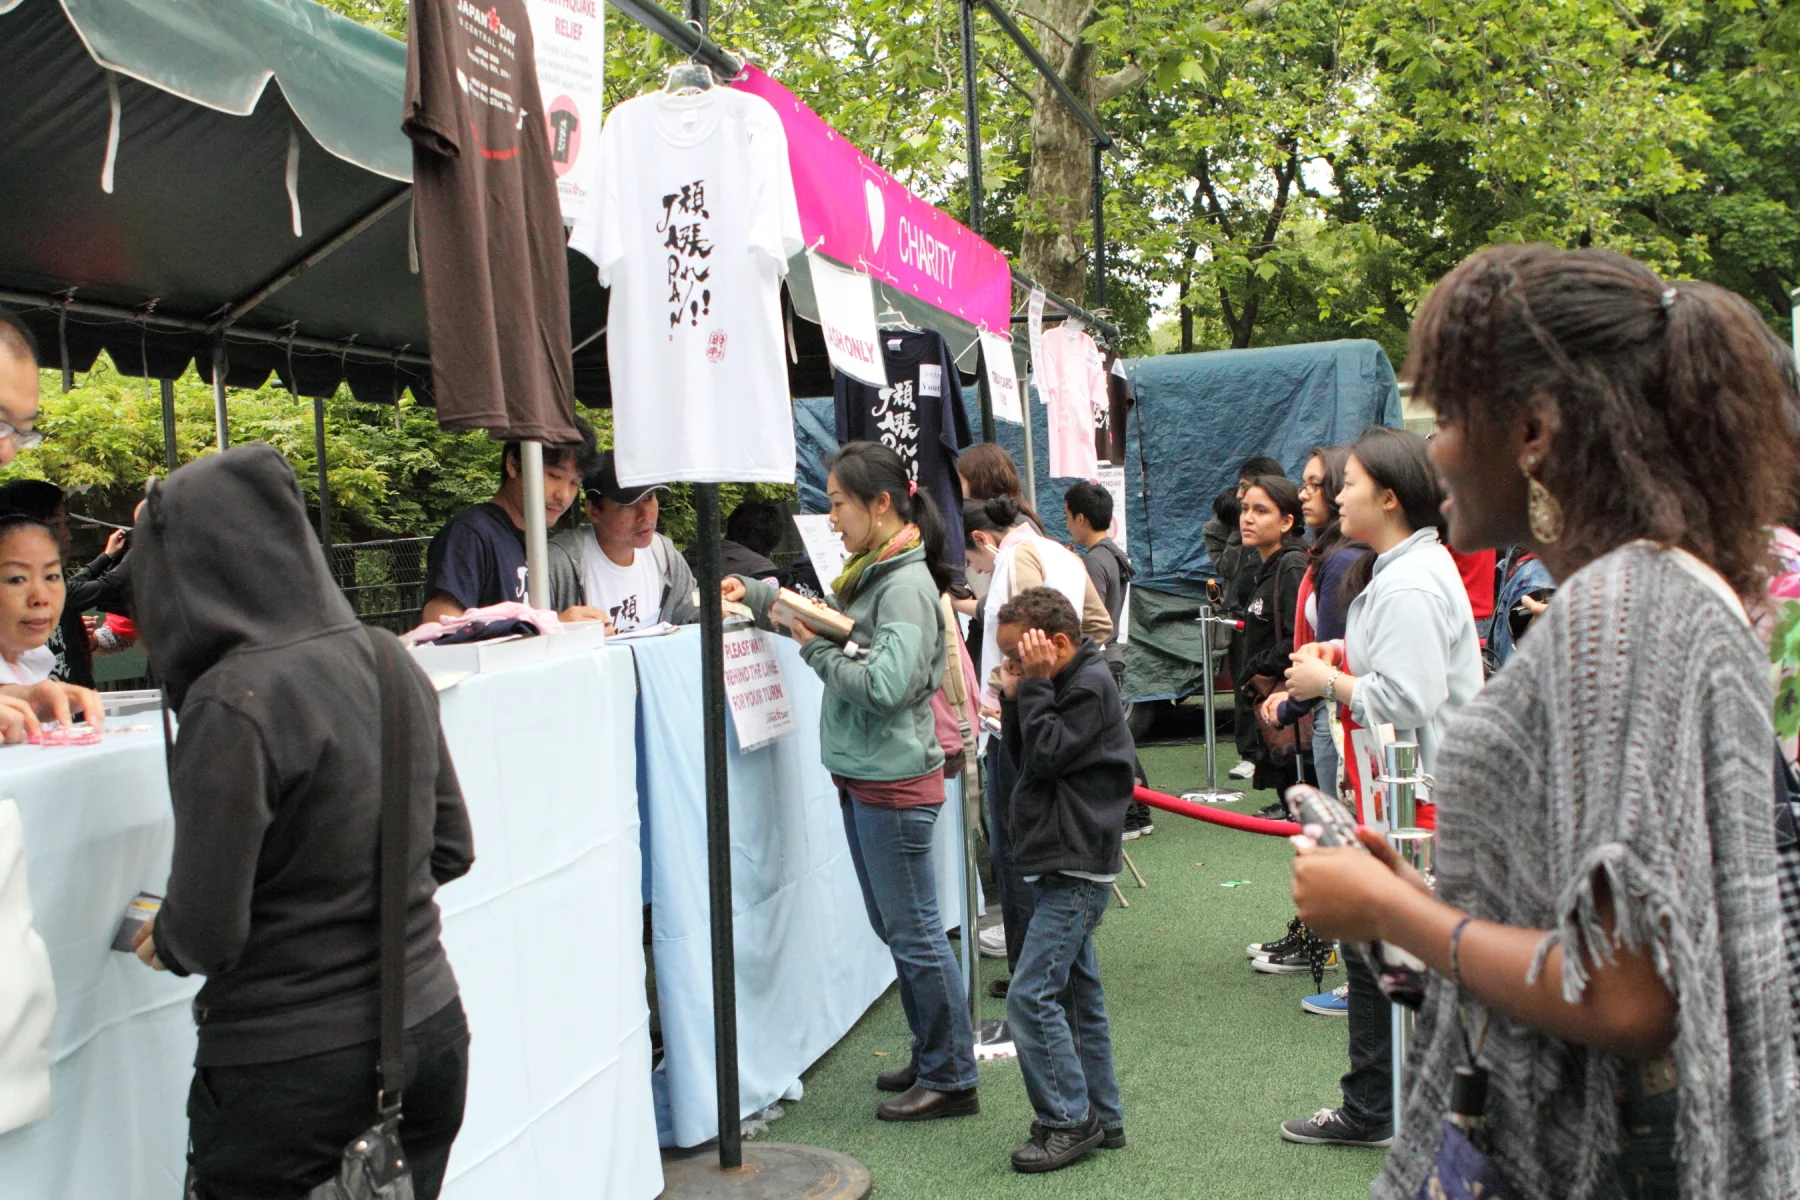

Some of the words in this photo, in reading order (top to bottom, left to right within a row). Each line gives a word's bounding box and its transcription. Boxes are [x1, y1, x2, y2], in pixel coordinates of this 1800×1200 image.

[457, 0, 487, 28] JAPAN
[500, 23, 516, 46] DAY
[555, 16, 582, 41] RELIEF
[465, 21, 495, 48] CENTRAL
[499, 42, 515, 60] PARK
[899, 215, 956, 290] CHARITY
[824, 322, 846, 353] ASH
[844, 335, 874, 364] ONLY
[725, 640, 750, 659] PLEASE
[749, 637, 765, 654] WAIT
[725, 666, 750, 686] BEHIND
[749, 663, 762, 681] THE
[761, 660, 778, 678] LINE
[732, 694, 746, 712] FOR
[744, 687, 764, 708] YOUR
[762, 684, 783, 702] TURN
